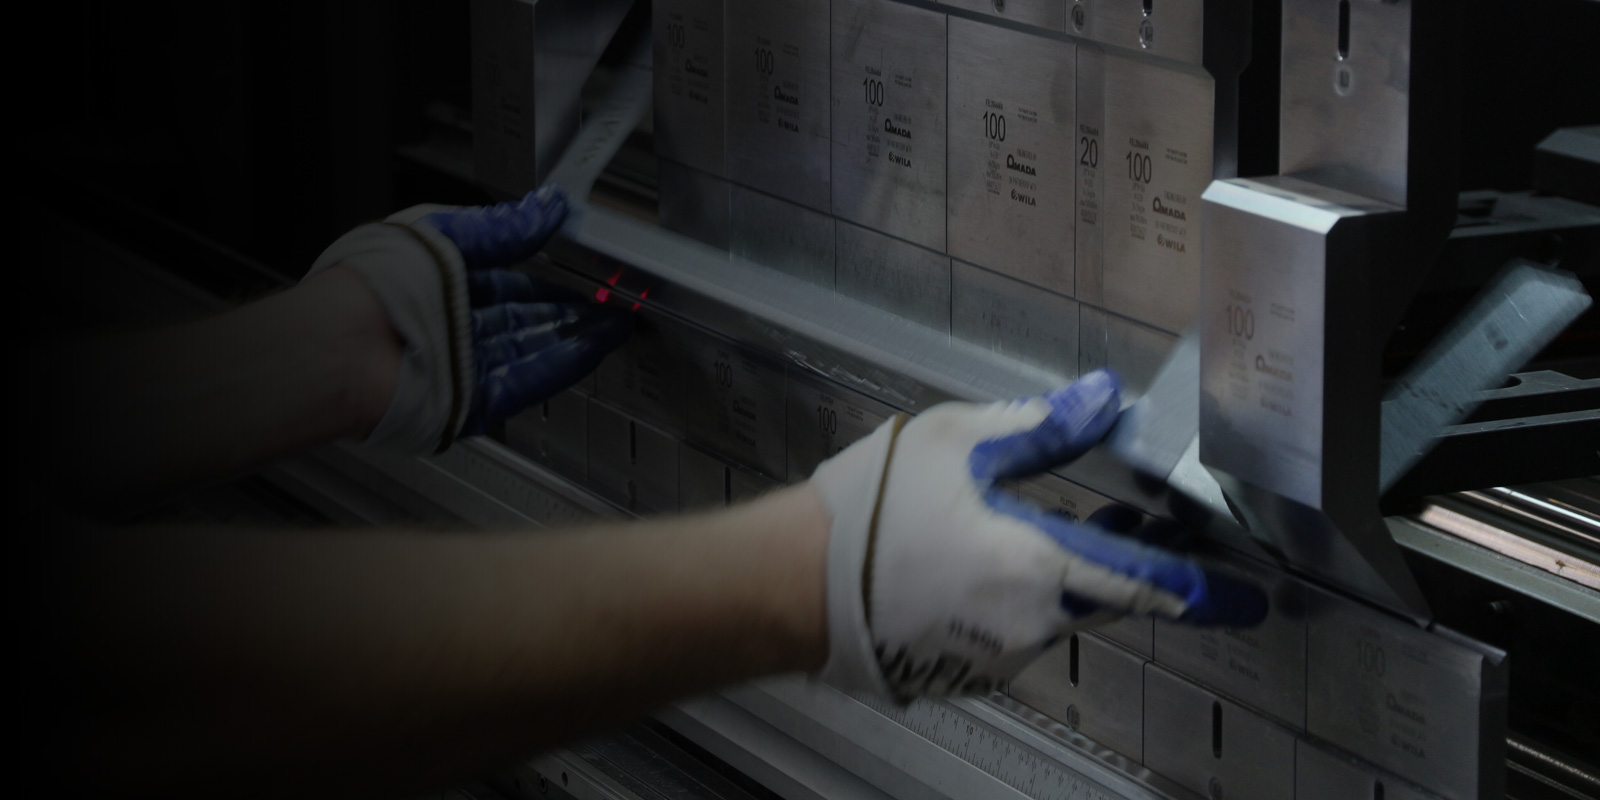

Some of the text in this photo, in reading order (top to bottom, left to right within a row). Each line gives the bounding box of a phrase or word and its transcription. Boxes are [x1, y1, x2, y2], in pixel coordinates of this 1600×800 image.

[667, 23, 686, 49] 100
[754, 47, 774, 76] 100
[862, 77, 884, 108] 100
[982, 110, 1006, 142] 100
[1080, 136, 1099, 168] 20
[1126, 150, 1152, 185] 100
[1225, 303, 1255, 341] 100
[714, 360, 733, 388] 100
[817, 405, 837, 435] 100
[1356, 638, 1386, 678] 100
